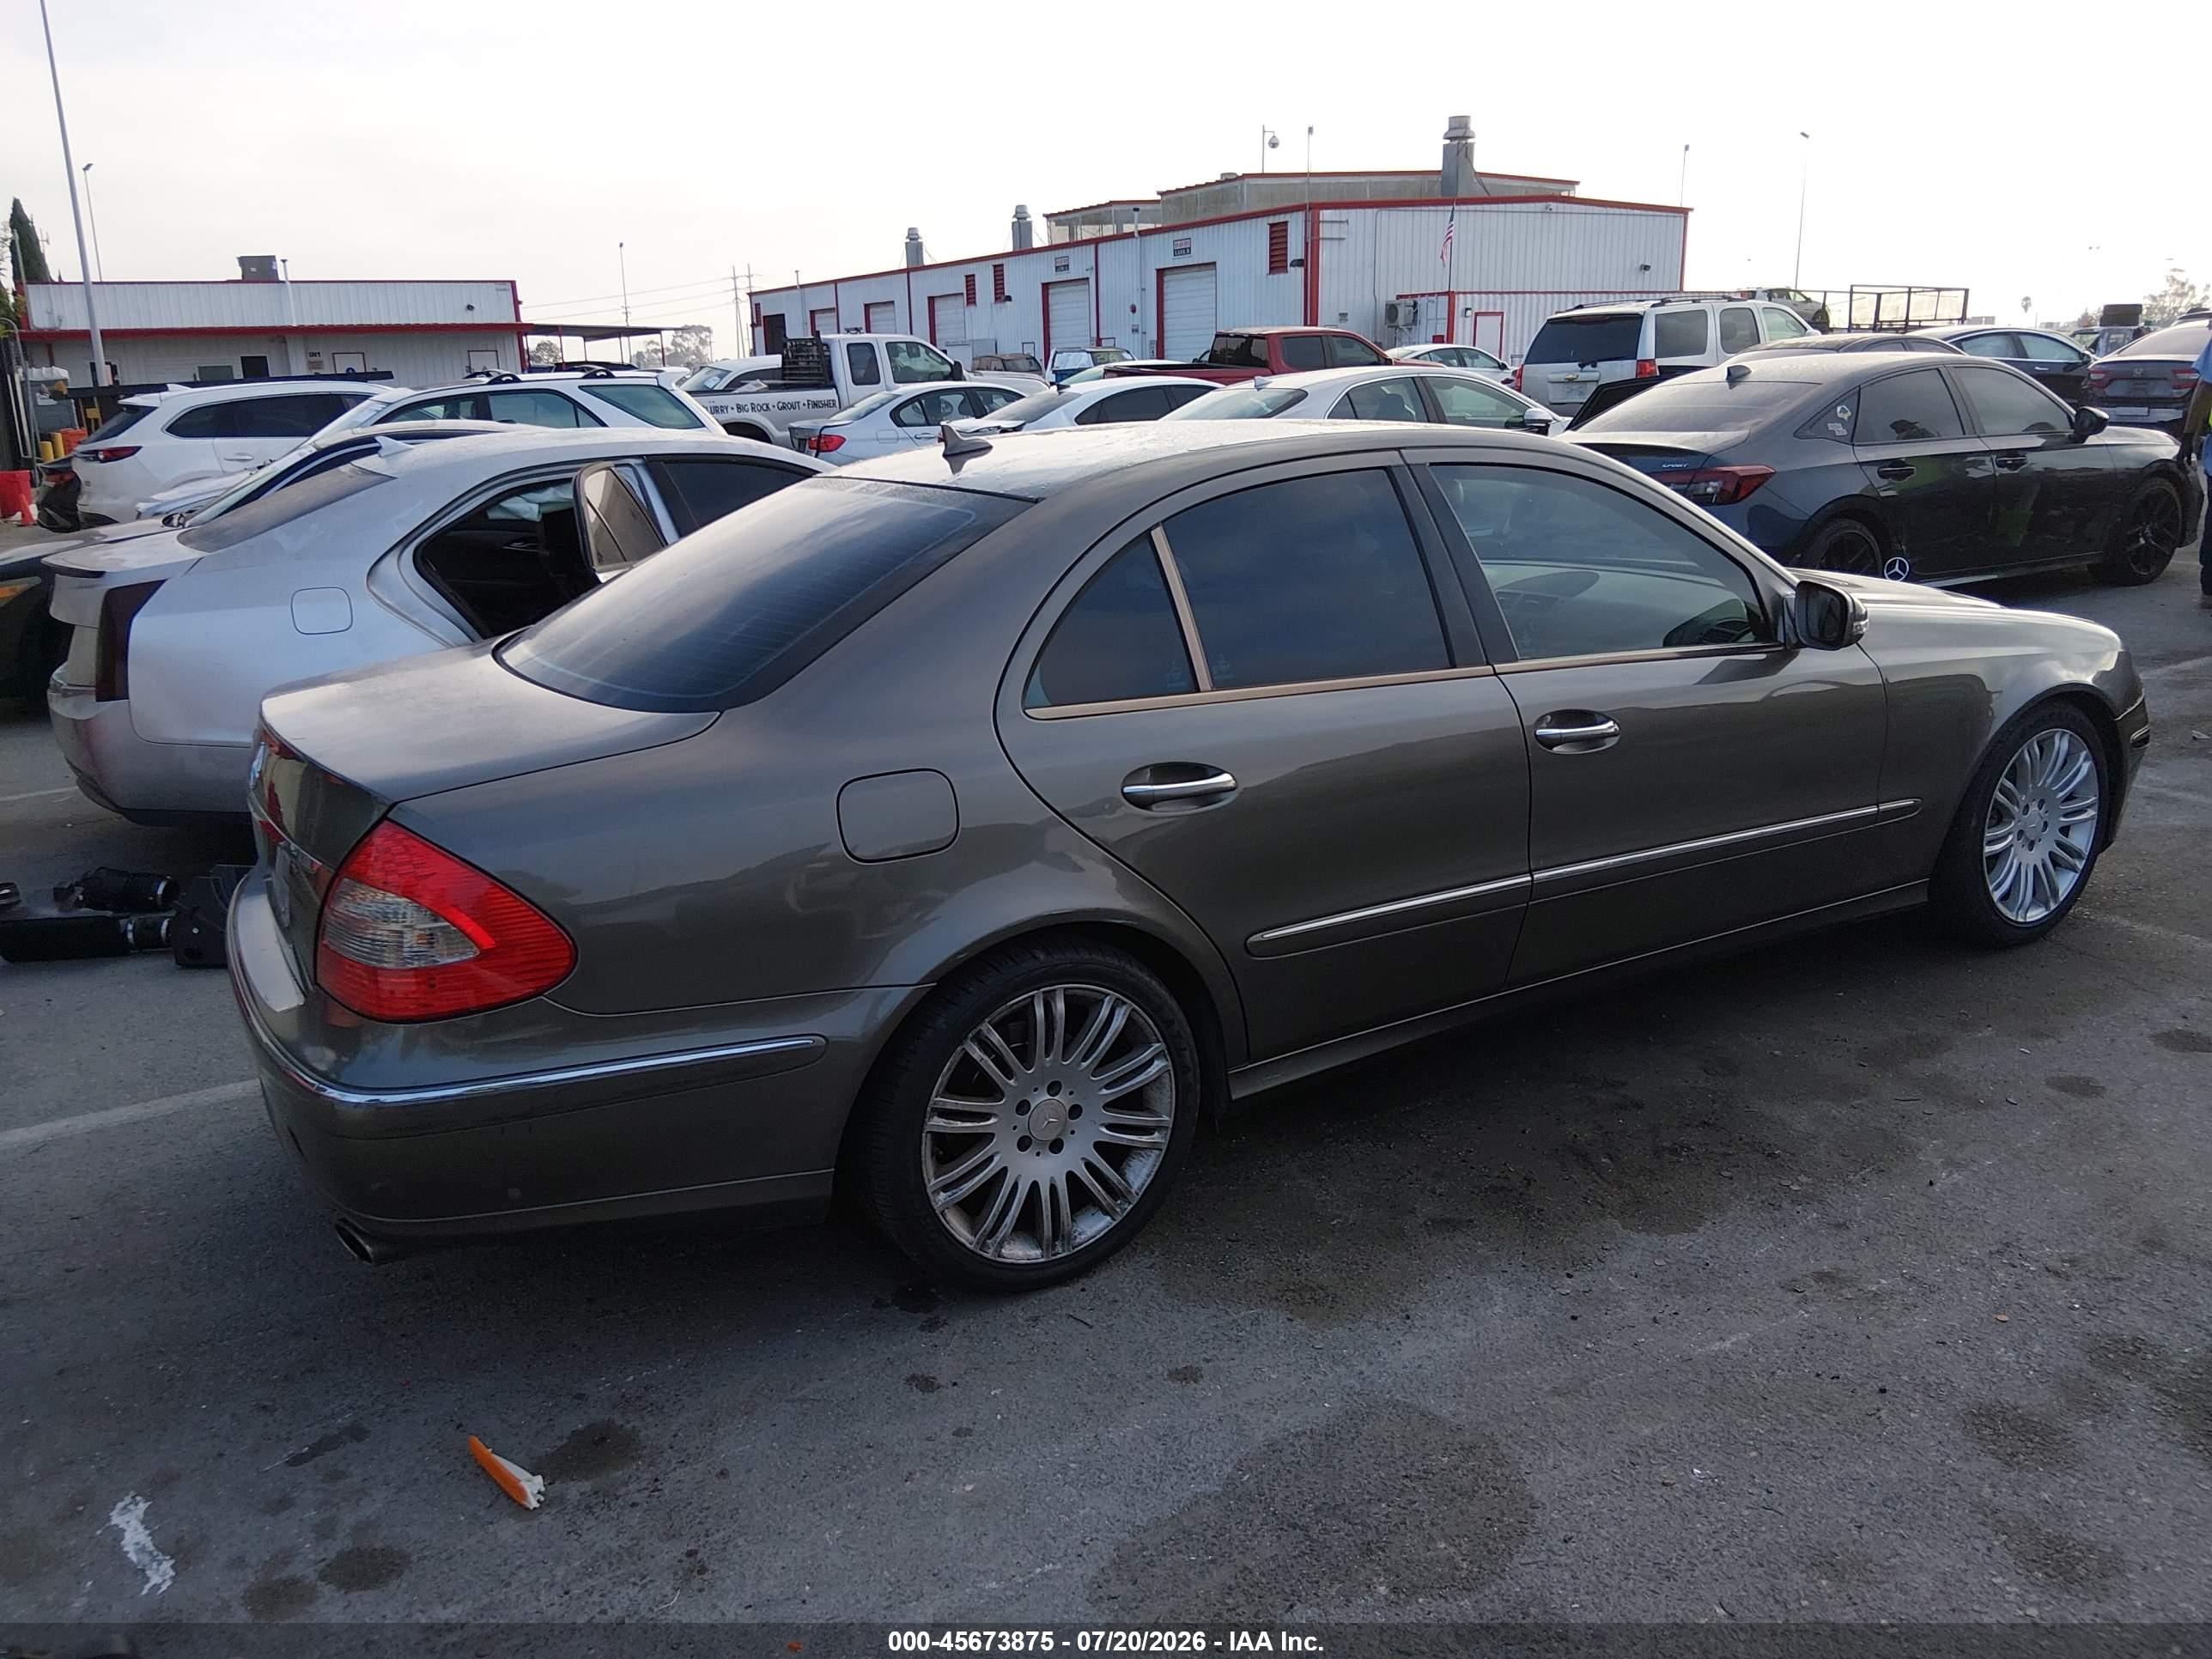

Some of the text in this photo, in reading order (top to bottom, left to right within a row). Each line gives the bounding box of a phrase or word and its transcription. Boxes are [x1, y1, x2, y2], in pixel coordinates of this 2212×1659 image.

[702, 399, 836, 415] URRY BIG ROCK GROUT FINISHER
